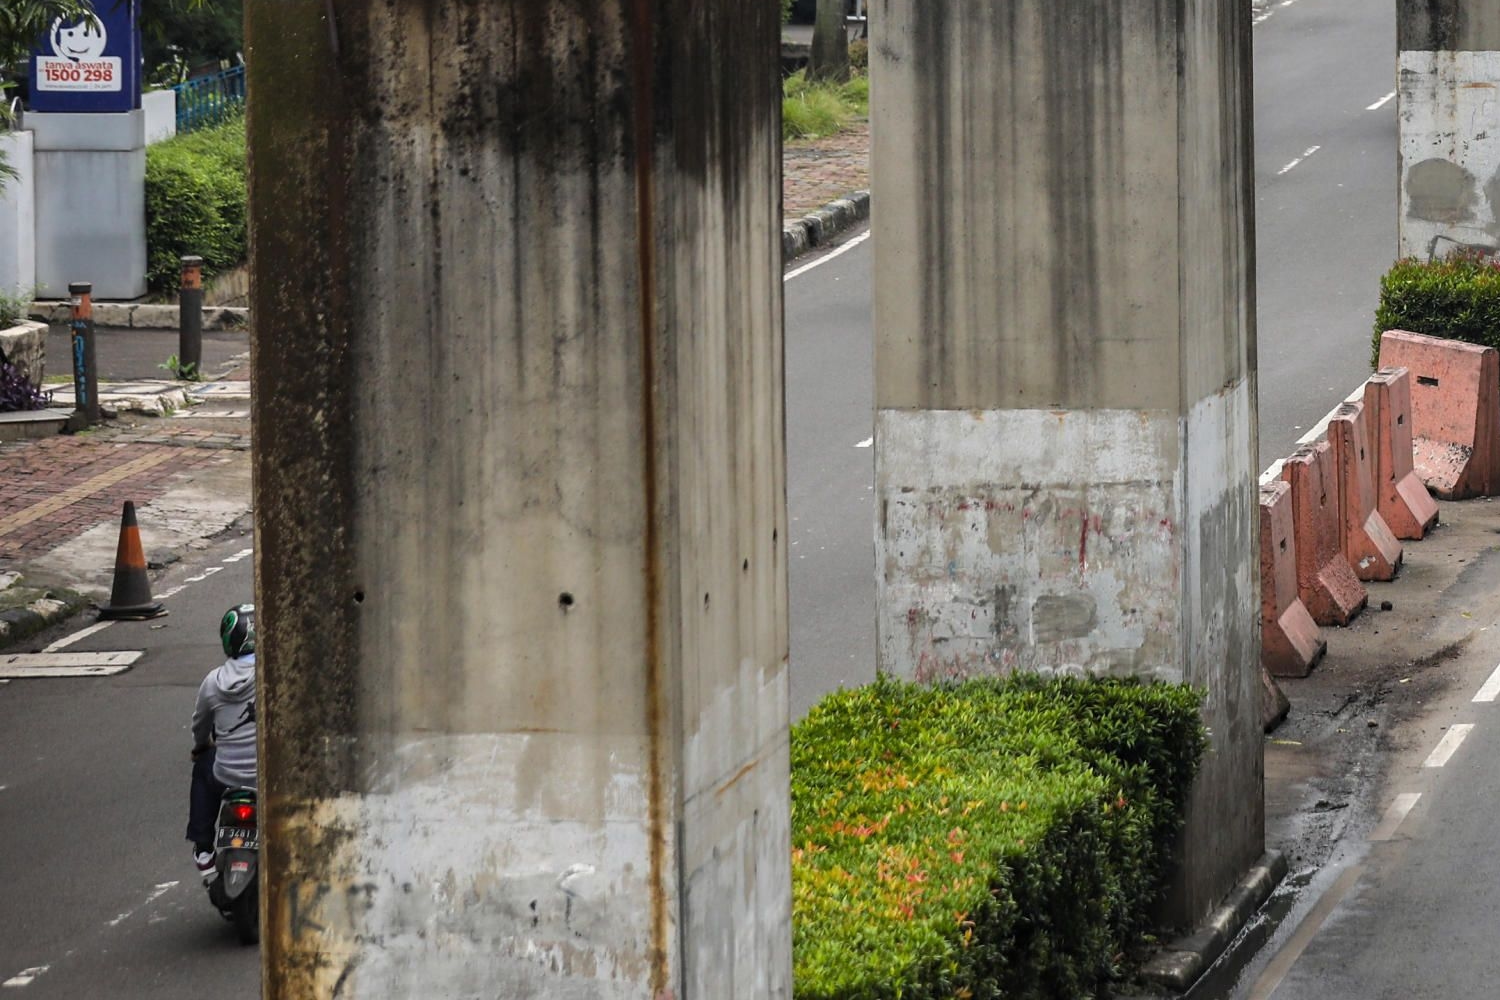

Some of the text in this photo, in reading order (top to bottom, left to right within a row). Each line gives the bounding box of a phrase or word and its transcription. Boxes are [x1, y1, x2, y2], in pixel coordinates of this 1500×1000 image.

[45, 61, 113, 71] tanya aswata
[45, 69, 113, 82] 1500 298
